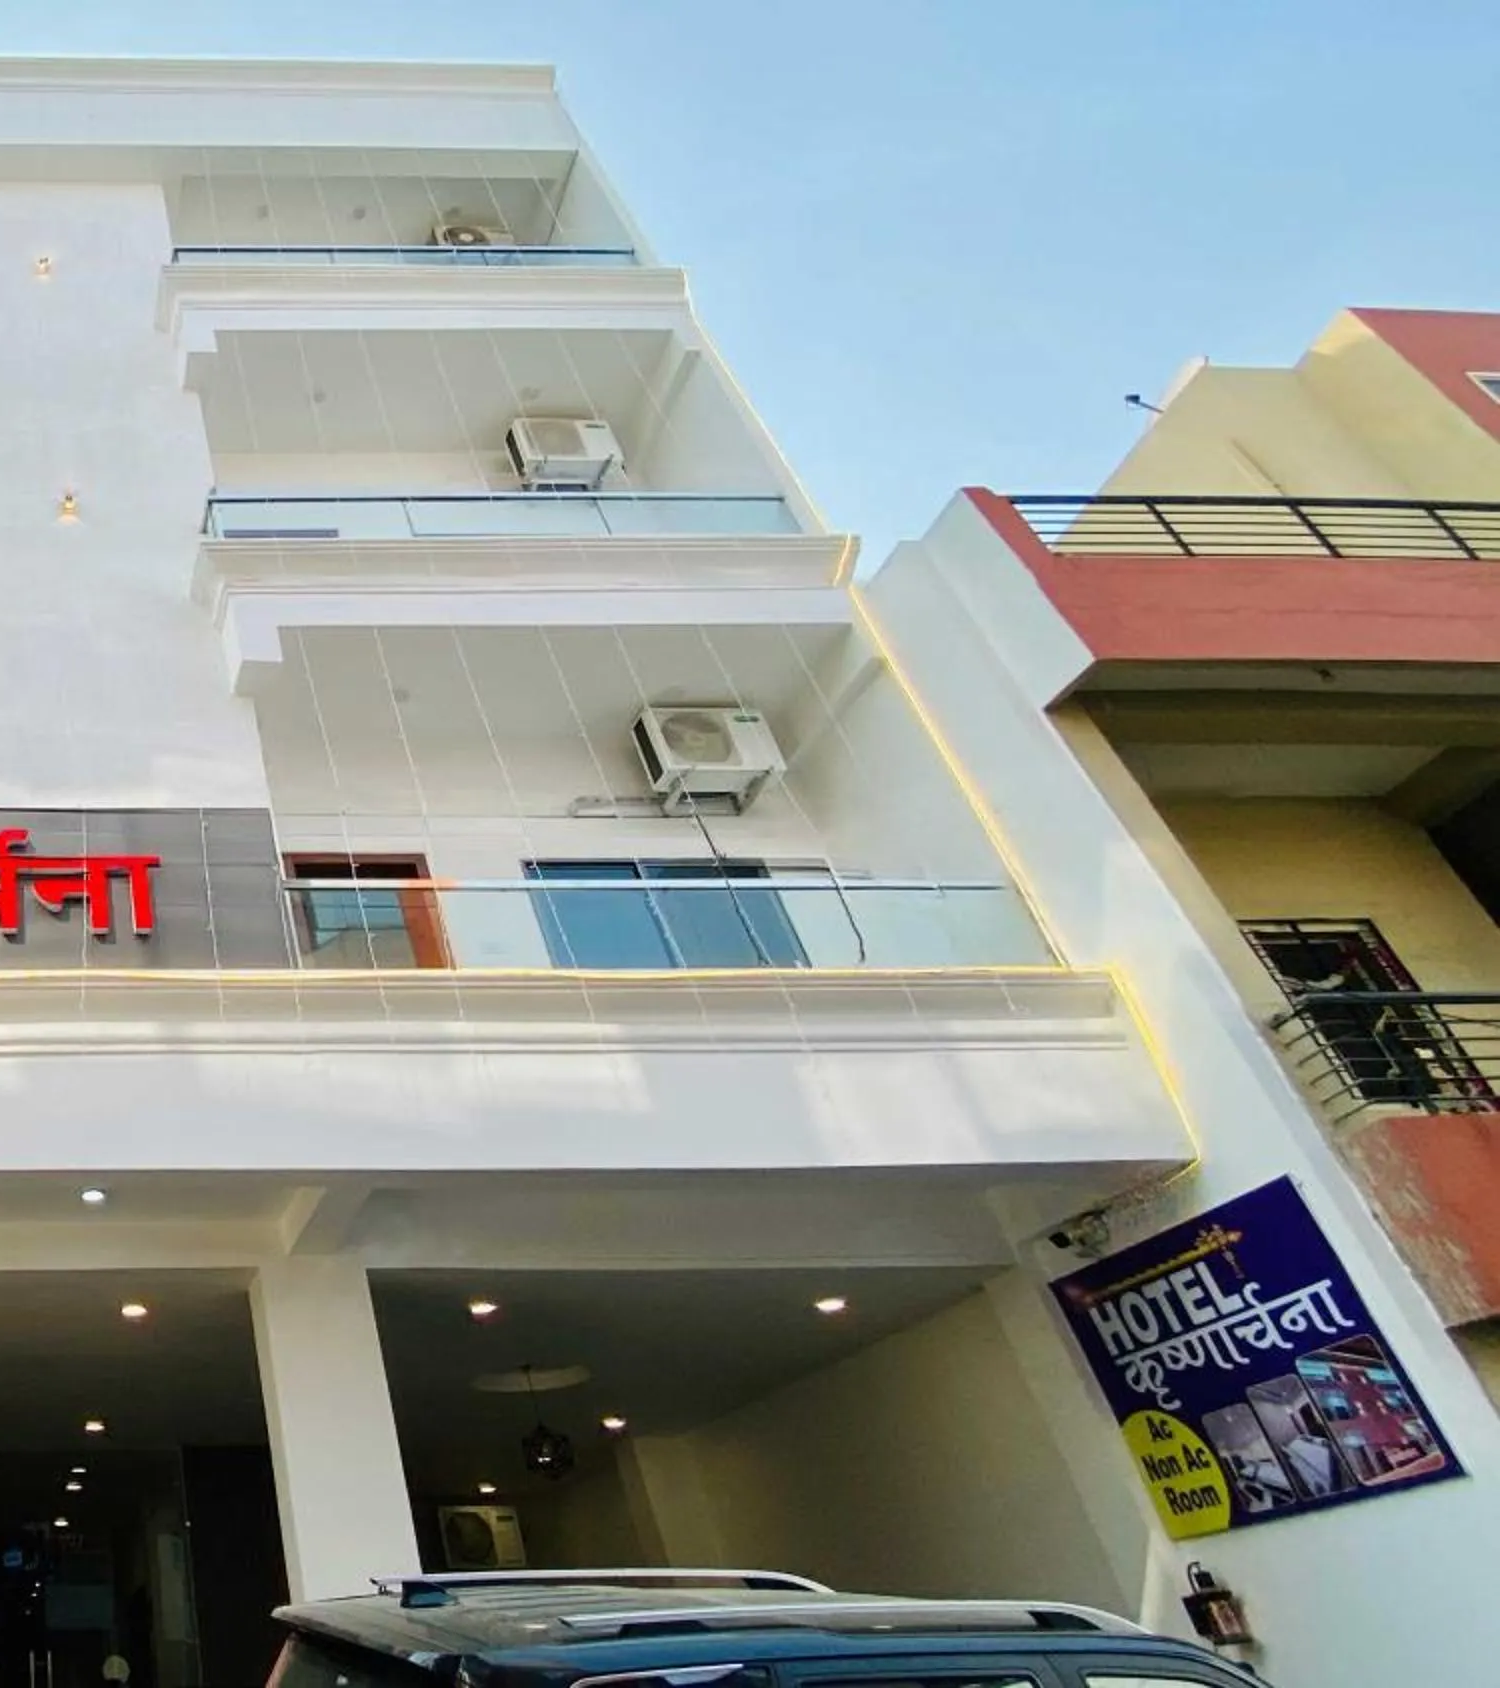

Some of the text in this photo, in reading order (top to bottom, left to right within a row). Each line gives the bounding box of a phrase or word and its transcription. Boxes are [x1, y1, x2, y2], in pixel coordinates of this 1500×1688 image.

[1088, 1261, 1242, 1358] HOTEL
[1113, 1279, 1357, 1411] कृष्णार्चना
[1147, 1416, 1173, 1442] Ac
[1142, 1441, 1211, 1481] Non Ac
[1164, 1485, 1221, 1516] Room
